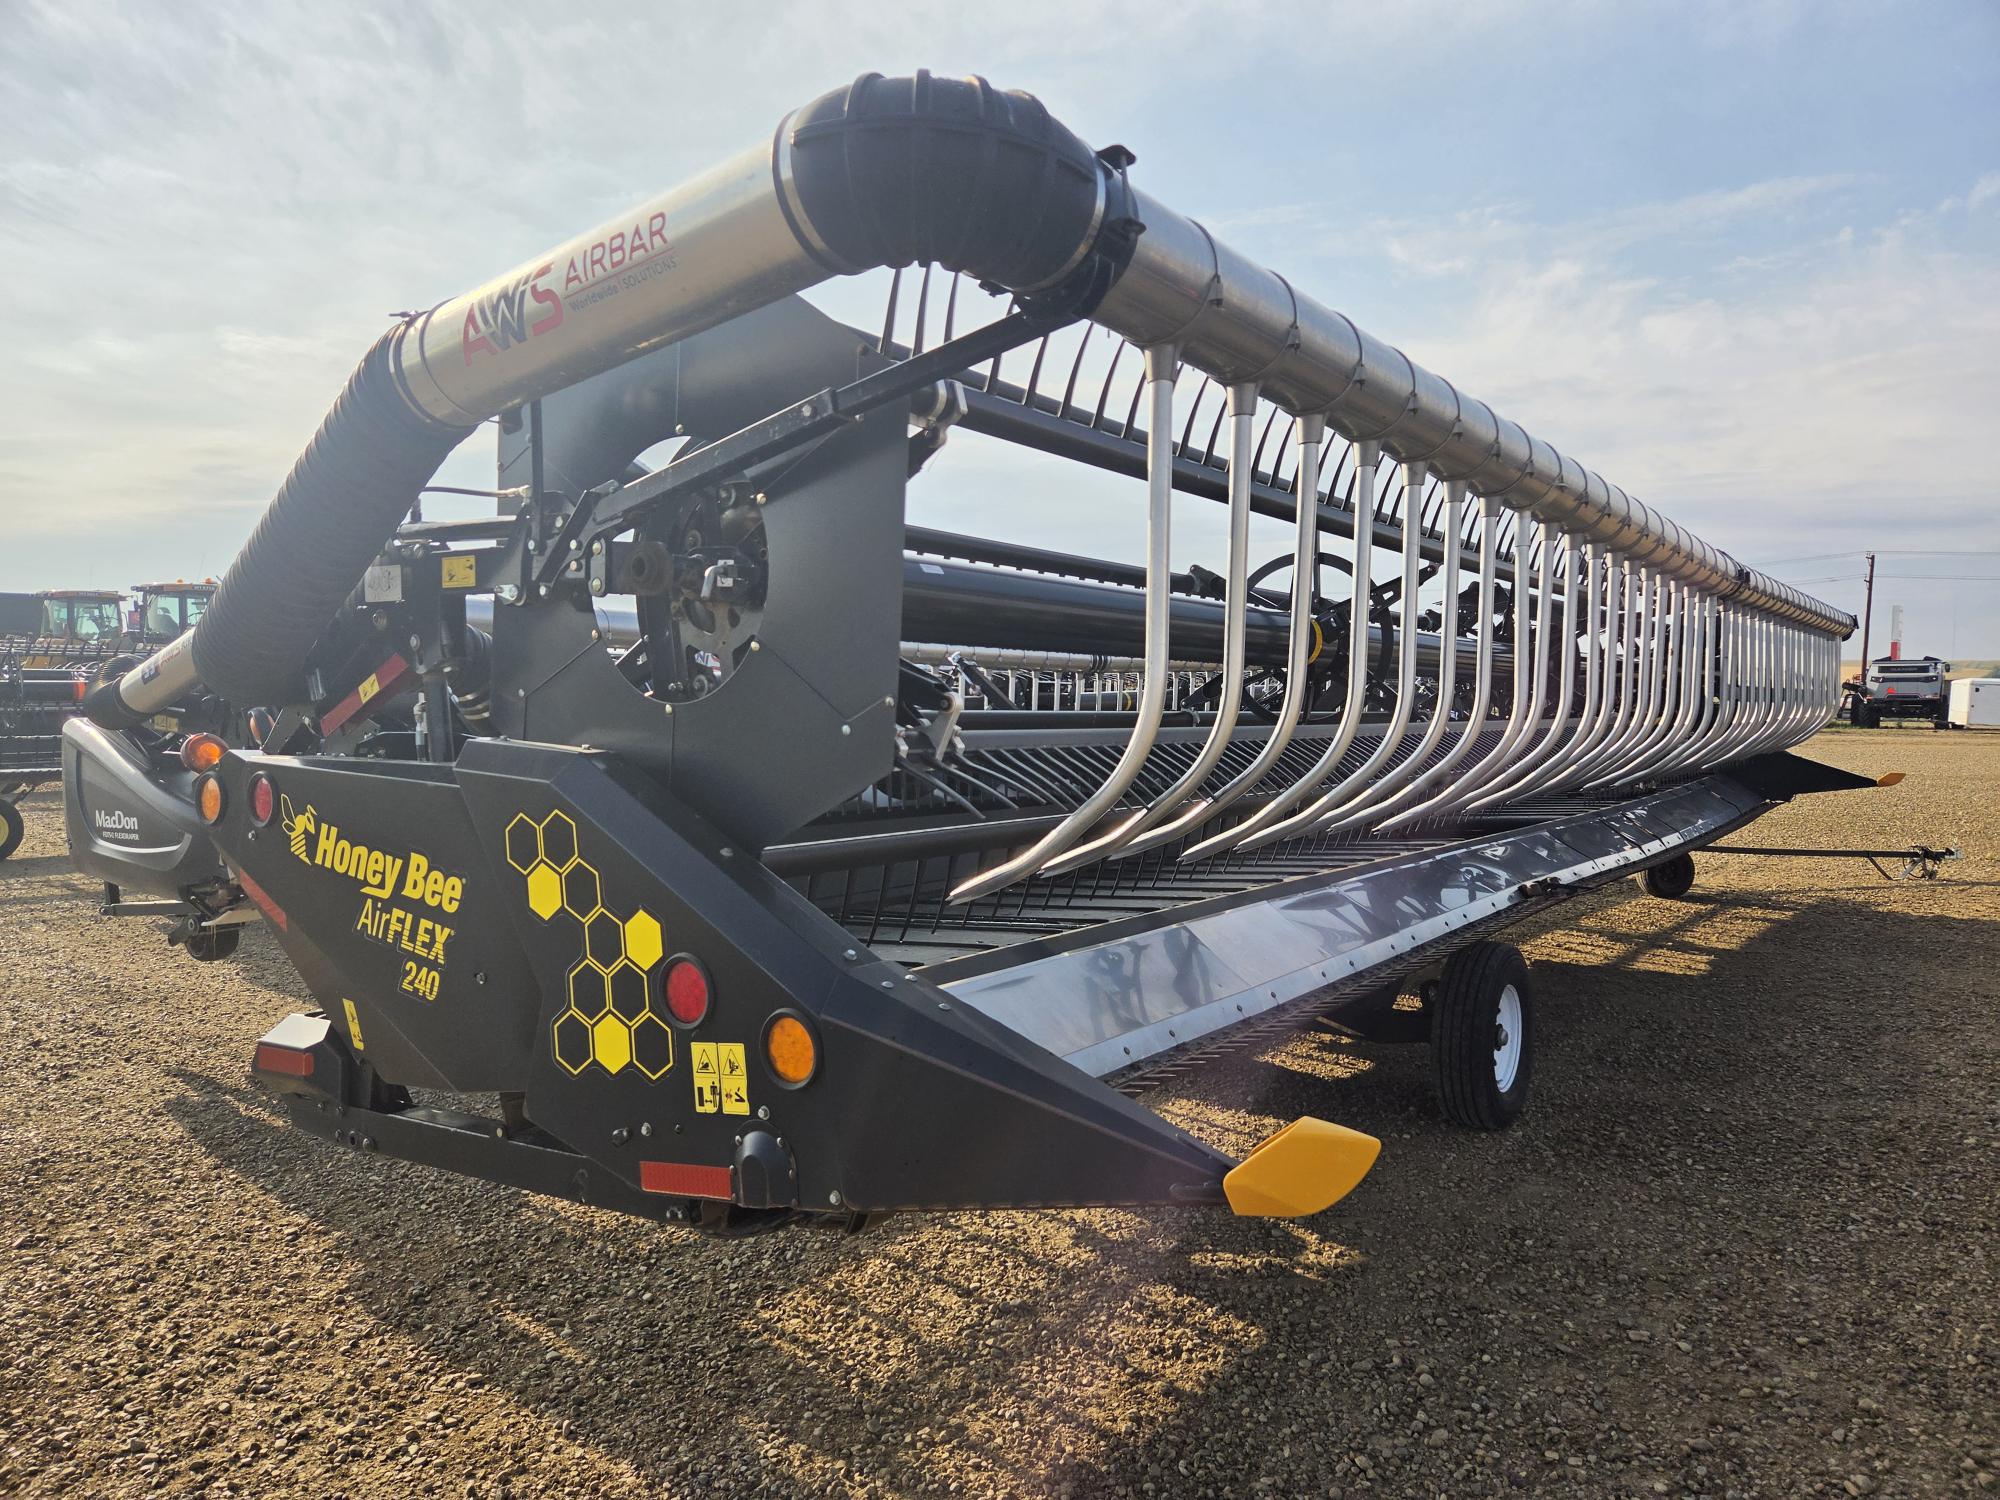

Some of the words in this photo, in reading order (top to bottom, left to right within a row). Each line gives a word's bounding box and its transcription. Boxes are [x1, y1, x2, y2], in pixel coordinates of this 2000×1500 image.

[463, 262, 564, 367] AWS
[565, 212, 667, 290] AIRBAR
[570, 284, 619, 312] Worldwide
[623, 256, 678, 289] SOLUTIONS
[95, 810, 138, 830] MacDon
[315, 822, 403, 900] Honey
[401, 852, 463, 914] Bee
[356, 898, 451, 966] AirFLEX
[401, 961, 440, 1001] 240
